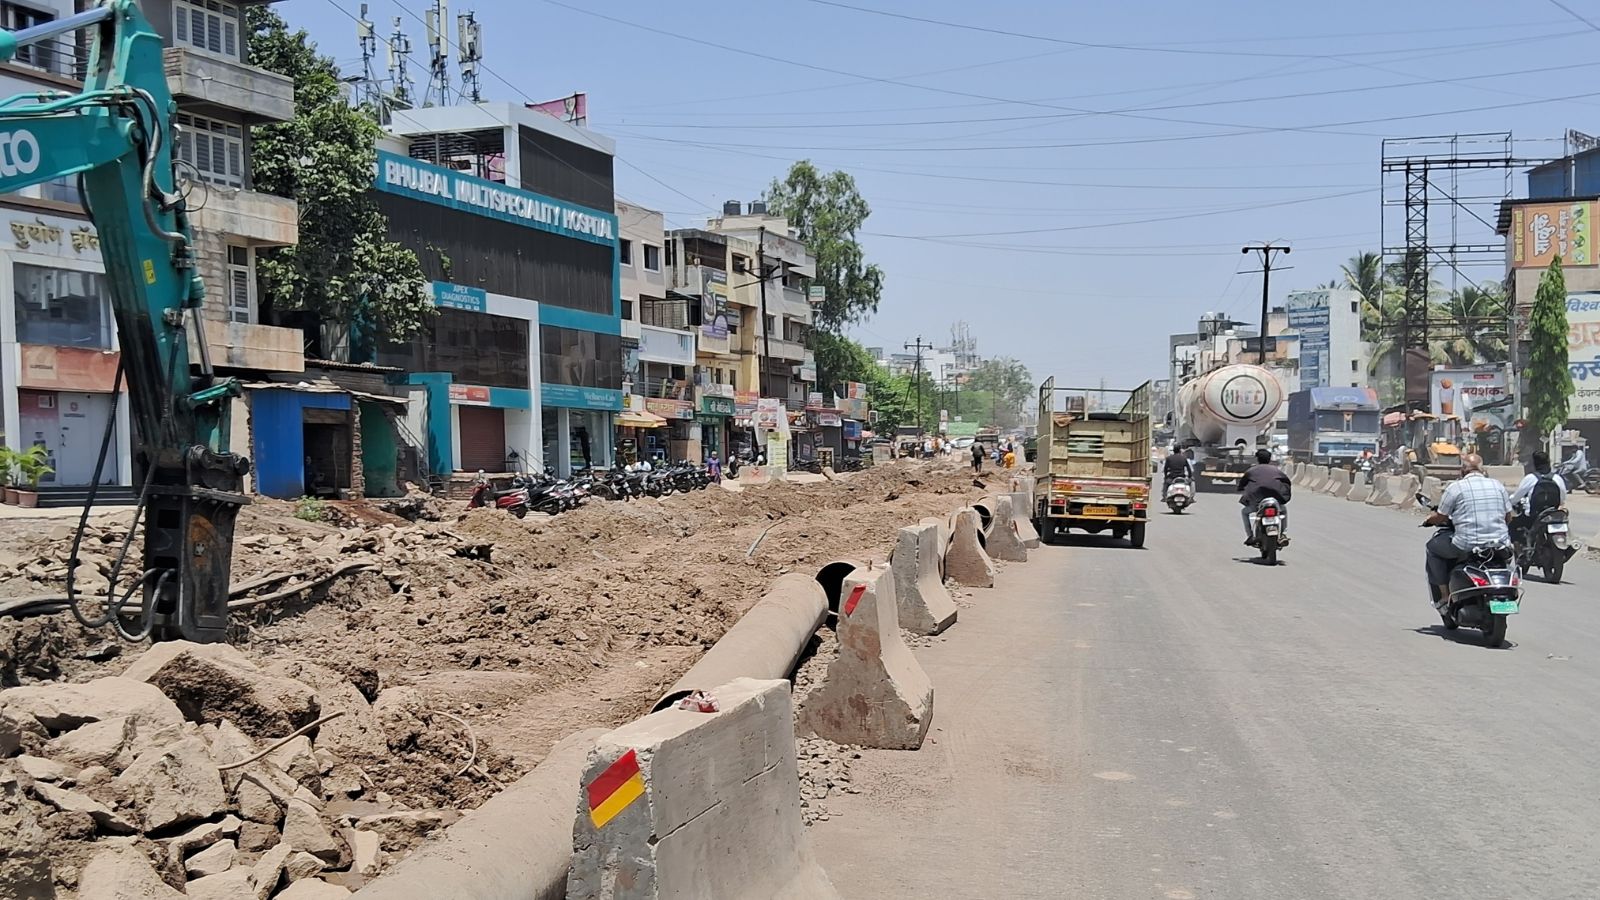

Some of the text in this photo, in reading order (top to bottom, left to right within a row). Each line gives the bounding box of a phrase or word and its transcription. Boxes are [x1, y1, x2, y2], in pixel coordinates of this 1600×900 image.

[385, 159, 615, 240] BHUJBAL MULTISPECIALITY HOSPITAL
[9, 216, 64, 249] सुयोग
[441, 291, 480, 305] DIAGNOSTICS
[1564, 298, 1600, 313] विश्व
